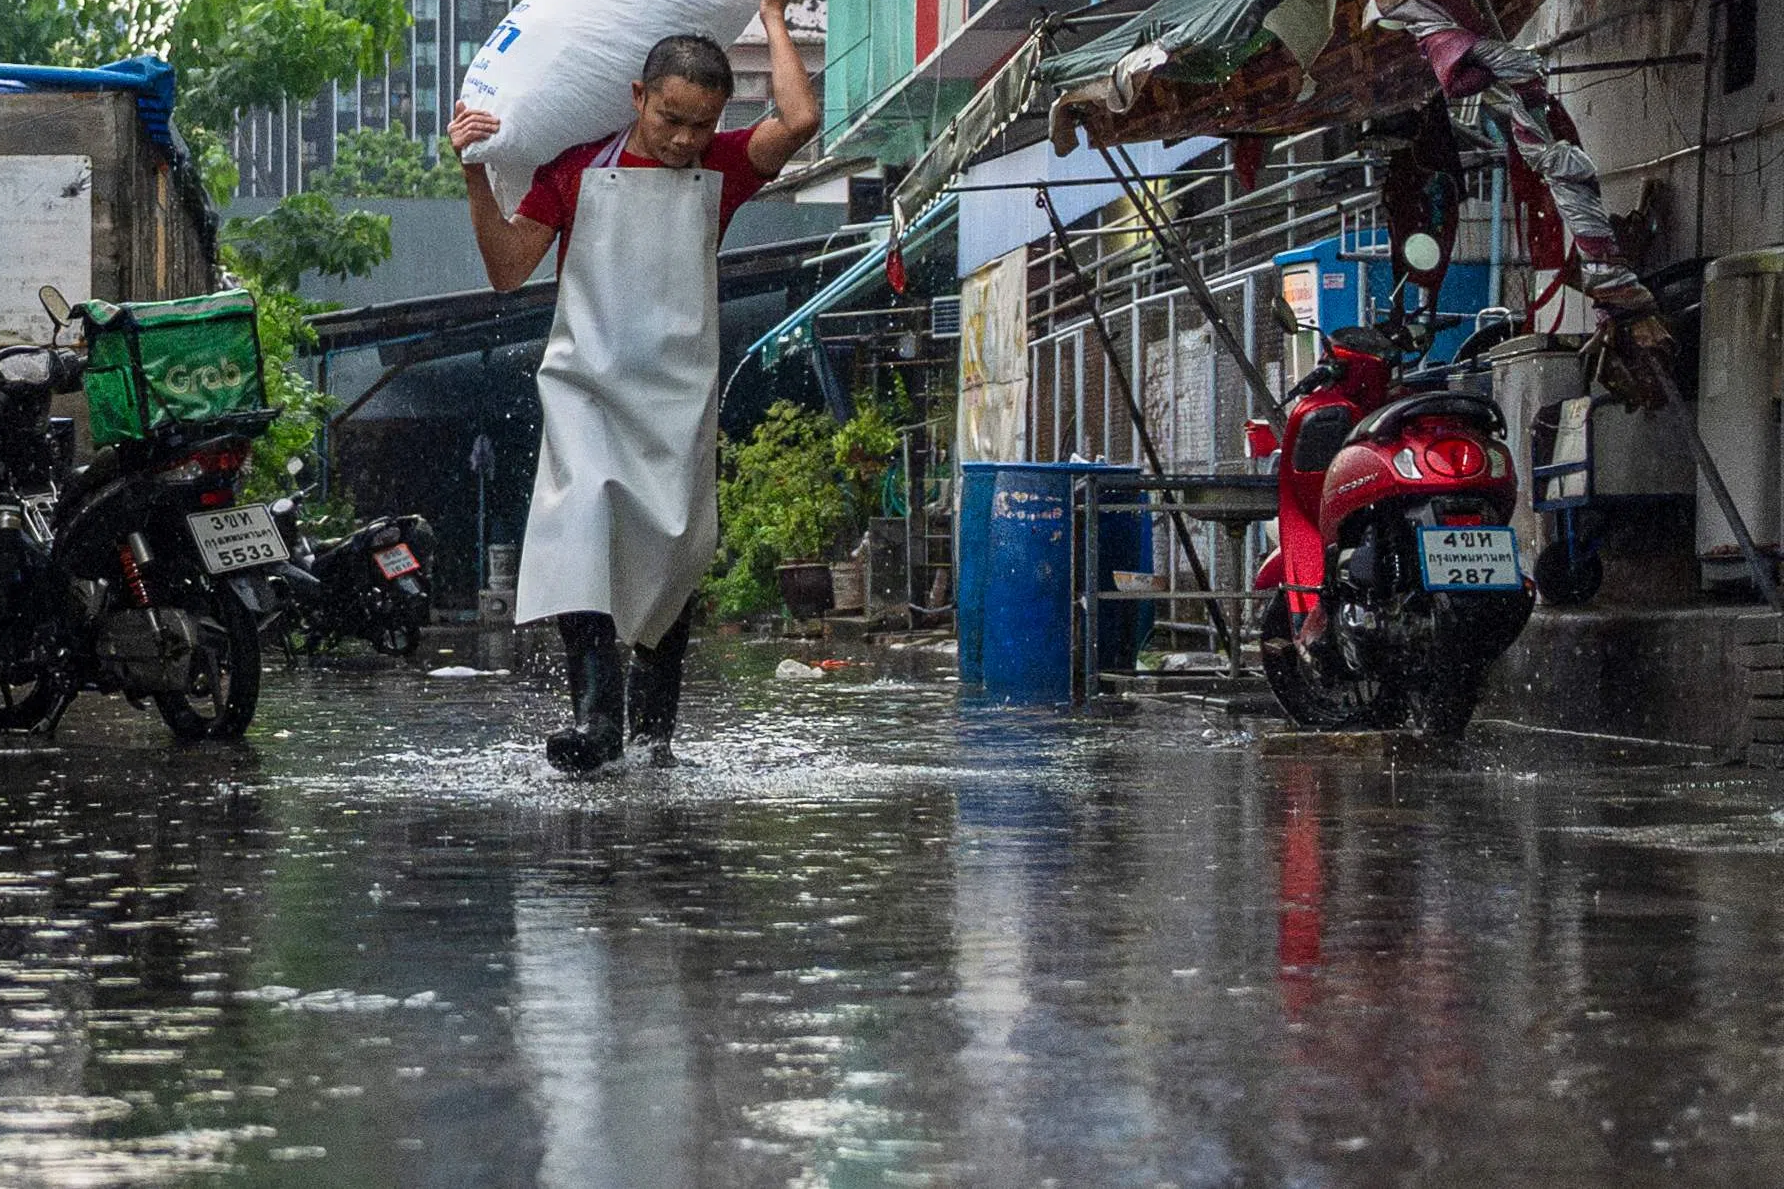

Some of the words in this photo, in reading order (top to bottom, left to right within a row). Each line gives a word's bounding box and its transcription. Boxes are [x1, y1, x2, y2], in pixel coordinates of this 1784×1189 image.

[166, 357, 241, 394] Grab
[218, 544, 274, 566] 5533
[1428, 553, 1513, 566] กรุงเทพมหานคร
[1447, 568, 1496, 584] 287
